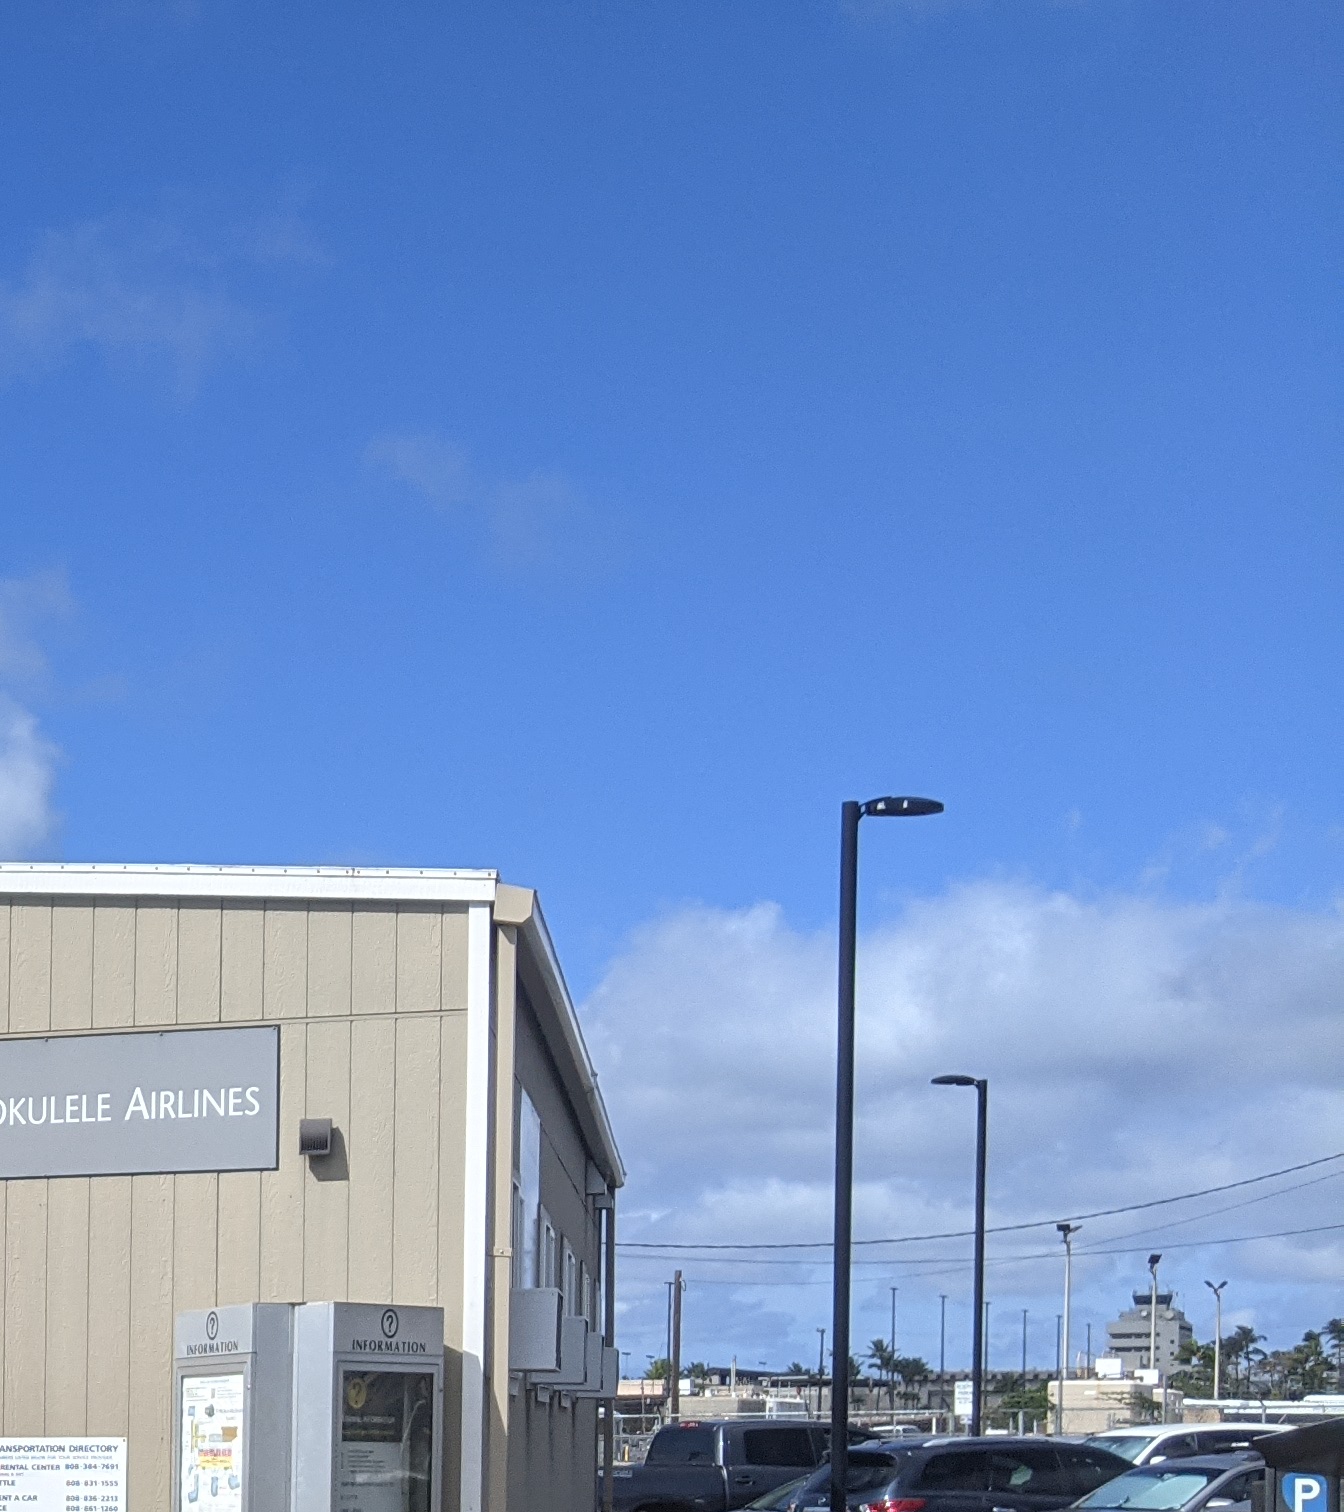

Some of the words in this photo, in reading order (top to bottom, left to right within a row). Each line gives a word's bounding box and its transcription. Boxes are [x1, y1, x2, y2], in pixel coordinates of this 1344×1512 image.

[125, 1086, 261, 1121] AIRLINES
[186, 1341, 239, 1356] INFORMATION
[352, 1339, 426, 1353] INFORMATION
[69, 1445, 119, 1453] DIRECTORY
